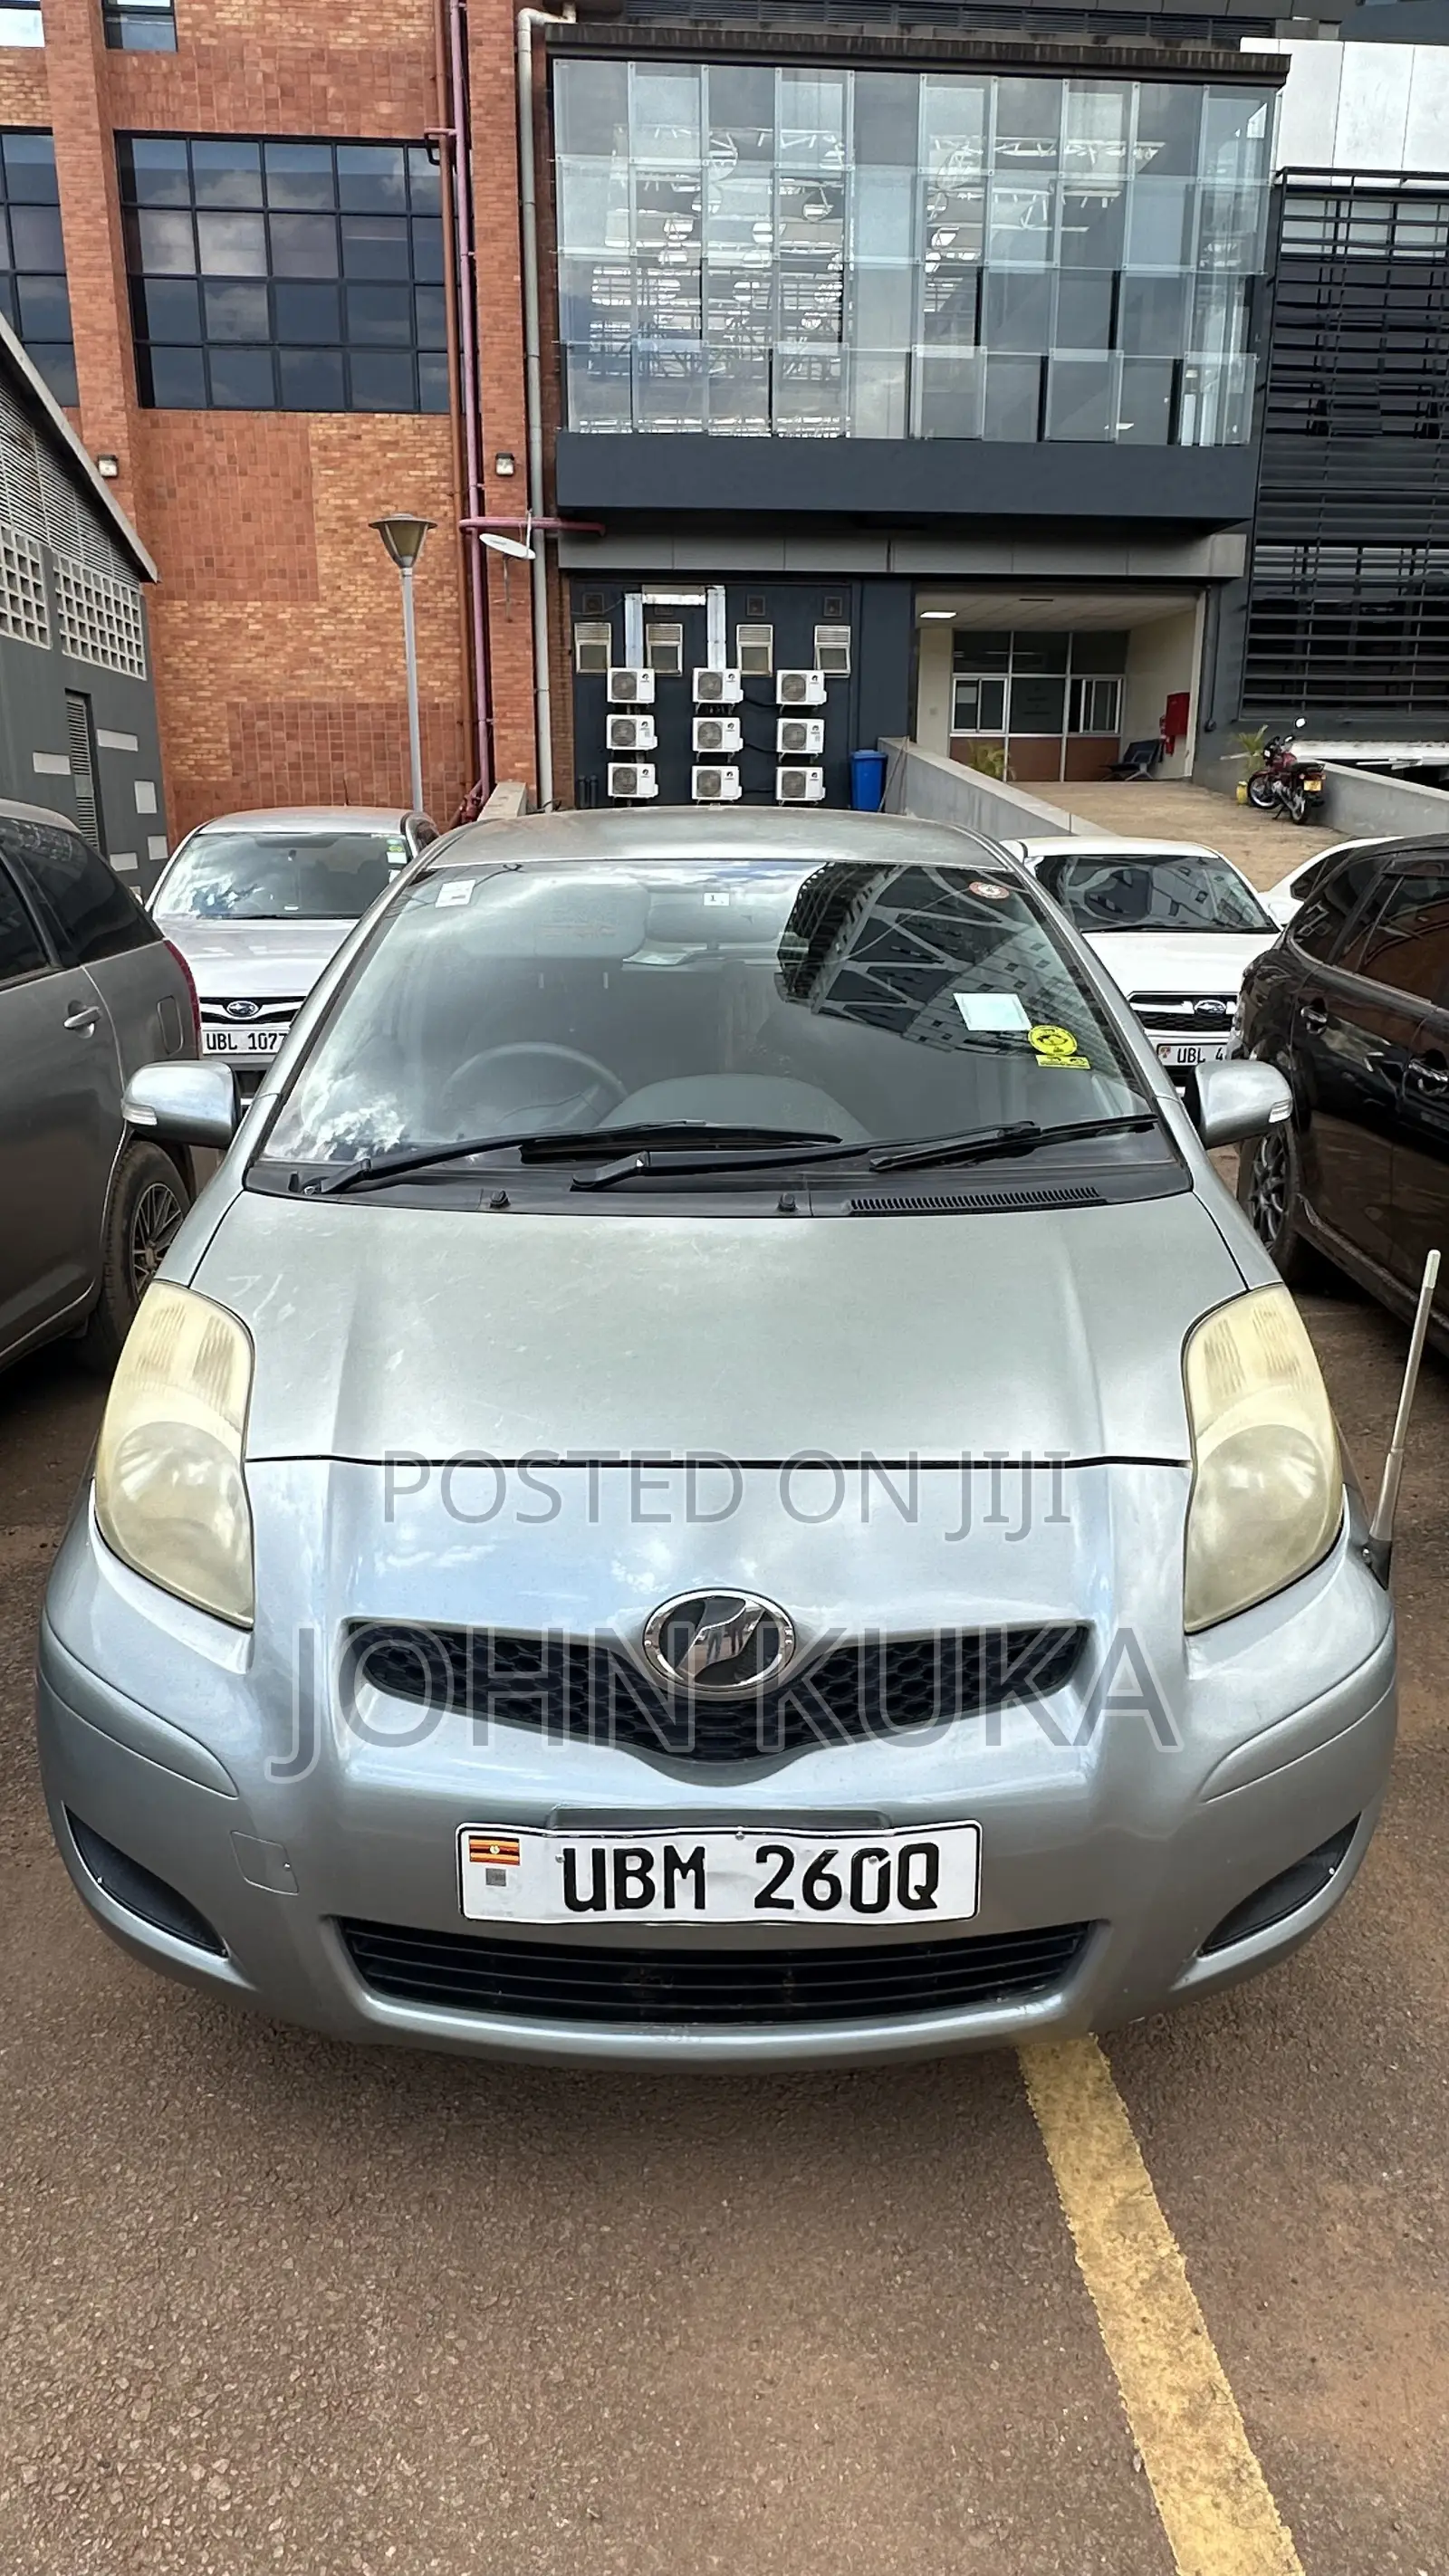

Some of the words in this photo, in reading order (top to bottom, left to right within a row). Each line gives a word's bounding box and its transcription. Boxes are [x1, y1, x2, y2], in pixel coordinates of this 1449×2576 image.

[206, 1033, 238, 1050] UBL
[1177, 1047, 1206, 1064] UBL
[562, 1844, 705, 1911] UBM
[753, 1843, 938, 1914] 260Q
